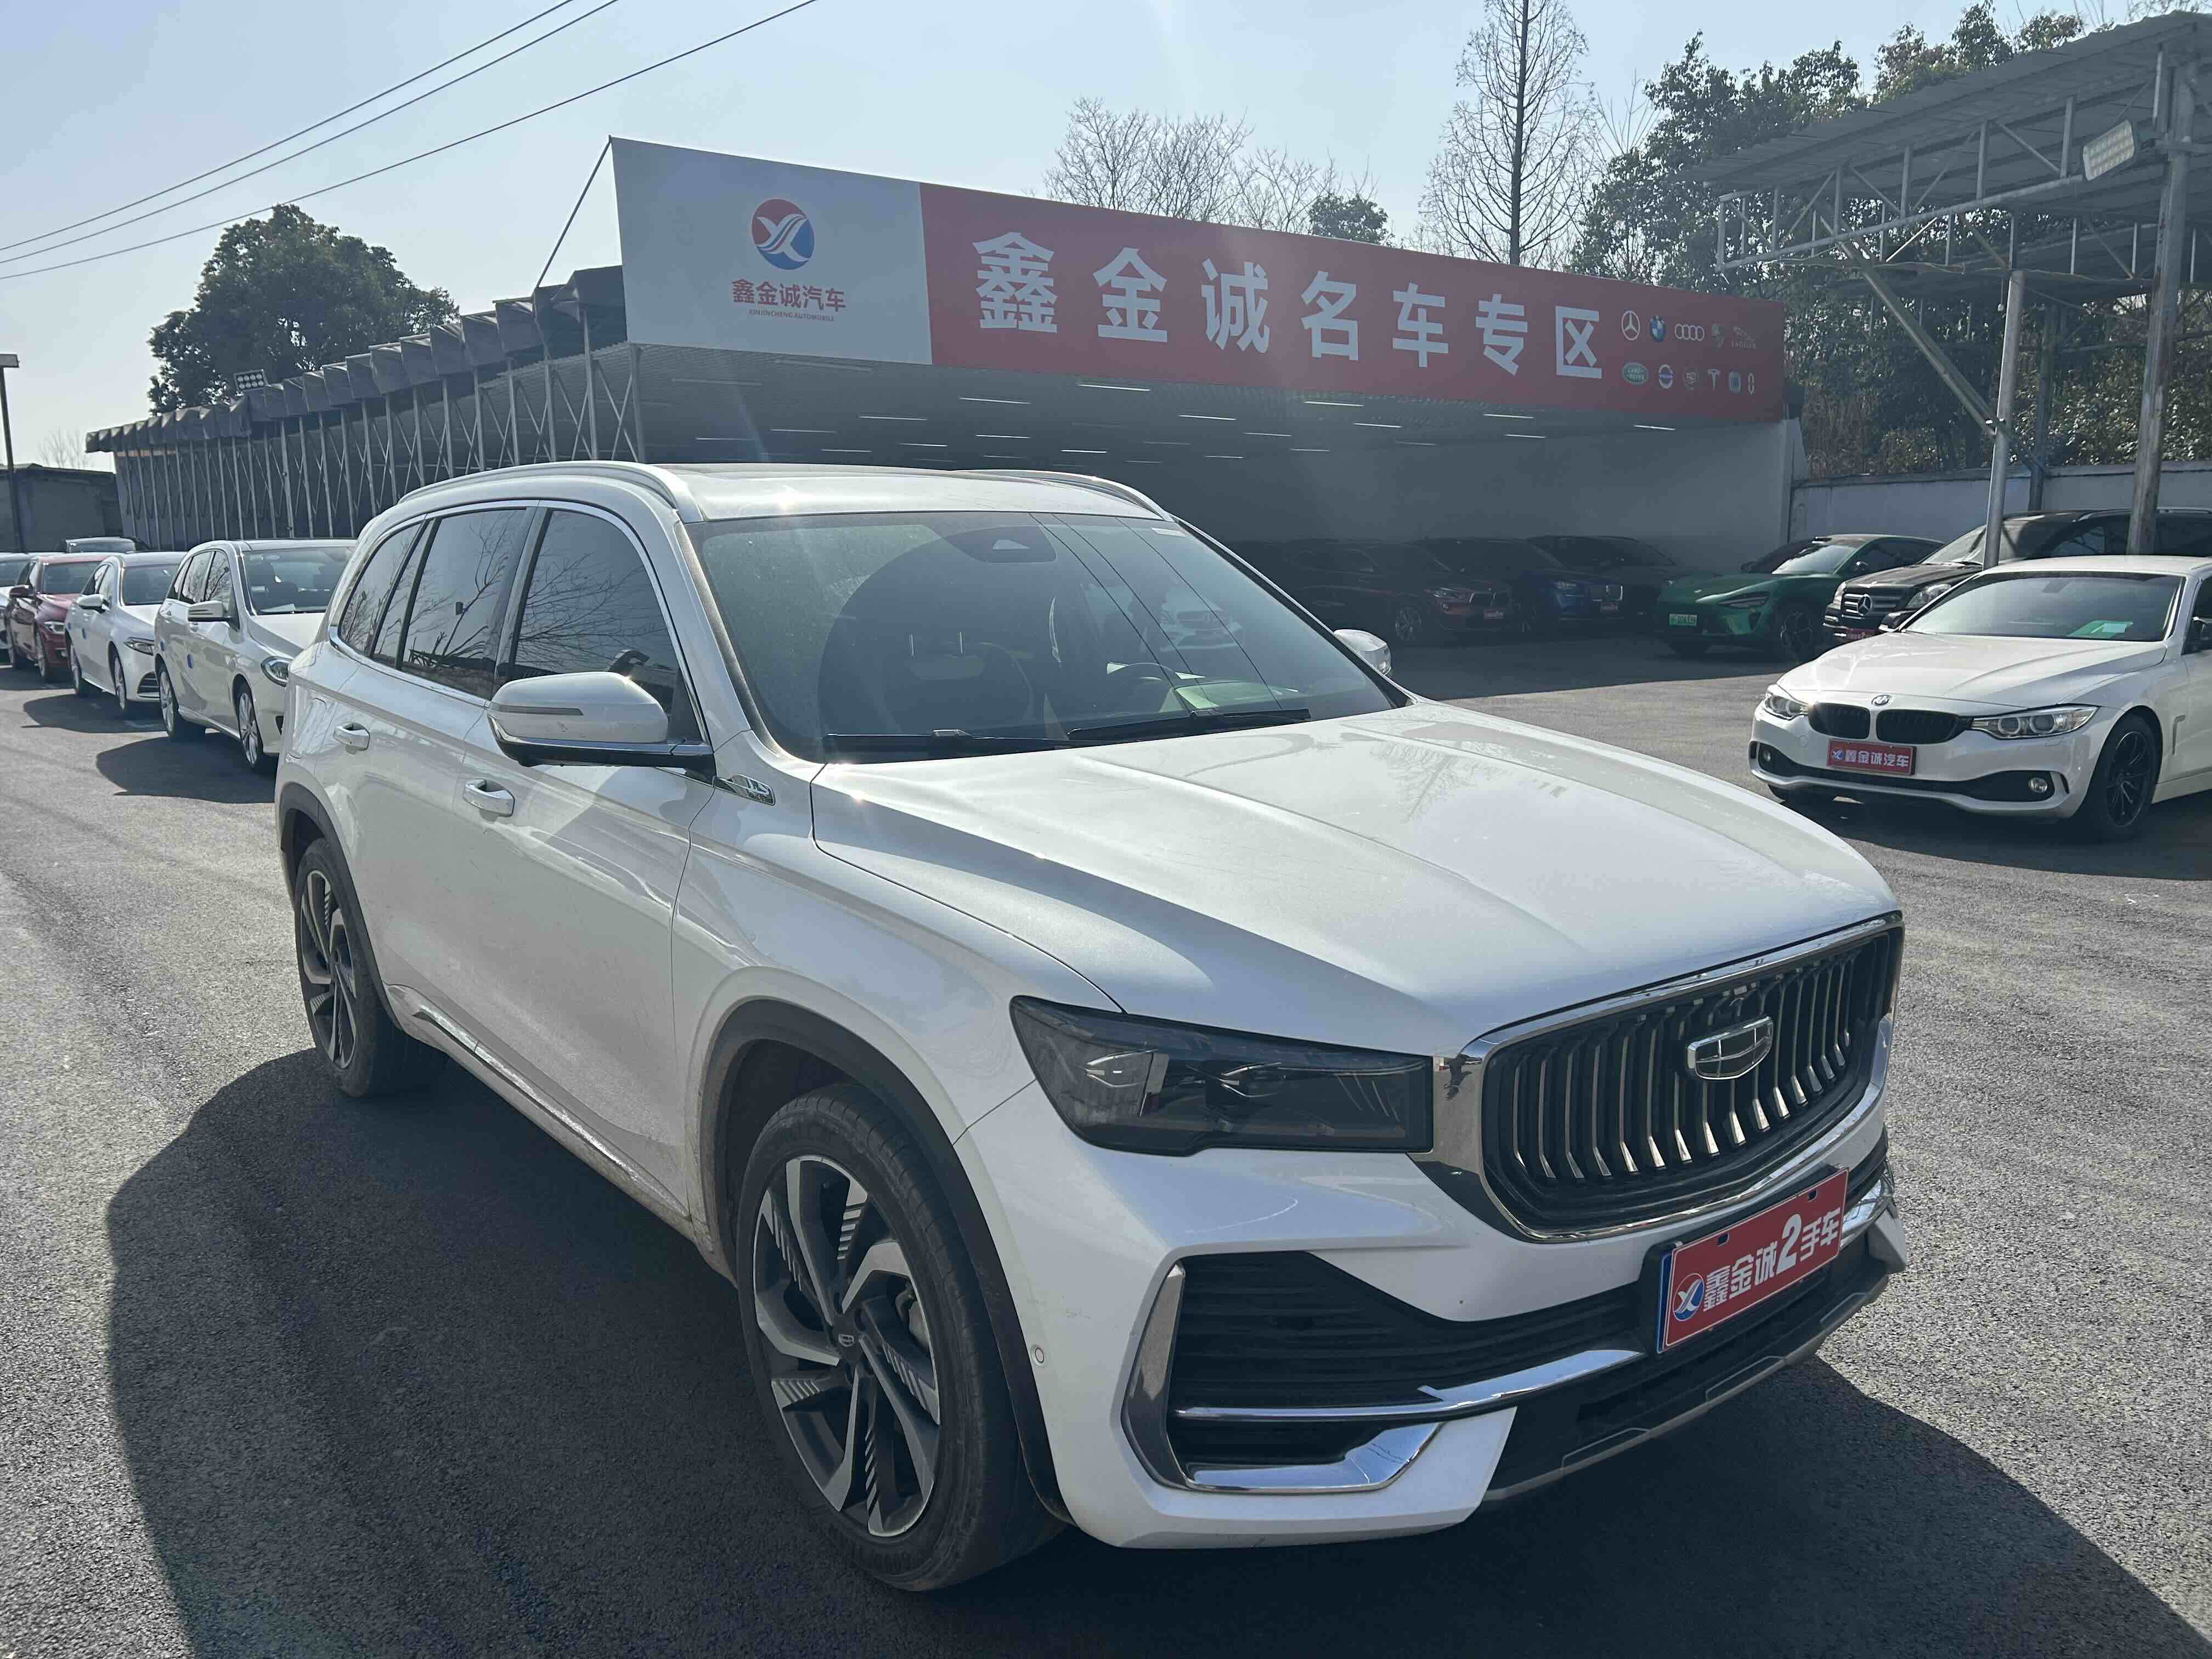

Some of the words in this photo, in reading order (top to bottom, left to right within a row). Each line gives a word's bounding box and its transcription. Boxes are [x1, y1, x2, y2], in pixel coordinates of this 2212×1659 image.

[731, 279, 846, 312] 鑫金诚汽车
[794, 313, 834, 321] AUTOMOBILE
[972, 232, 1602, 379] 鑫金诚名车专区
[1703, 1207, 1841, 1312] 鑫金诚2手车
